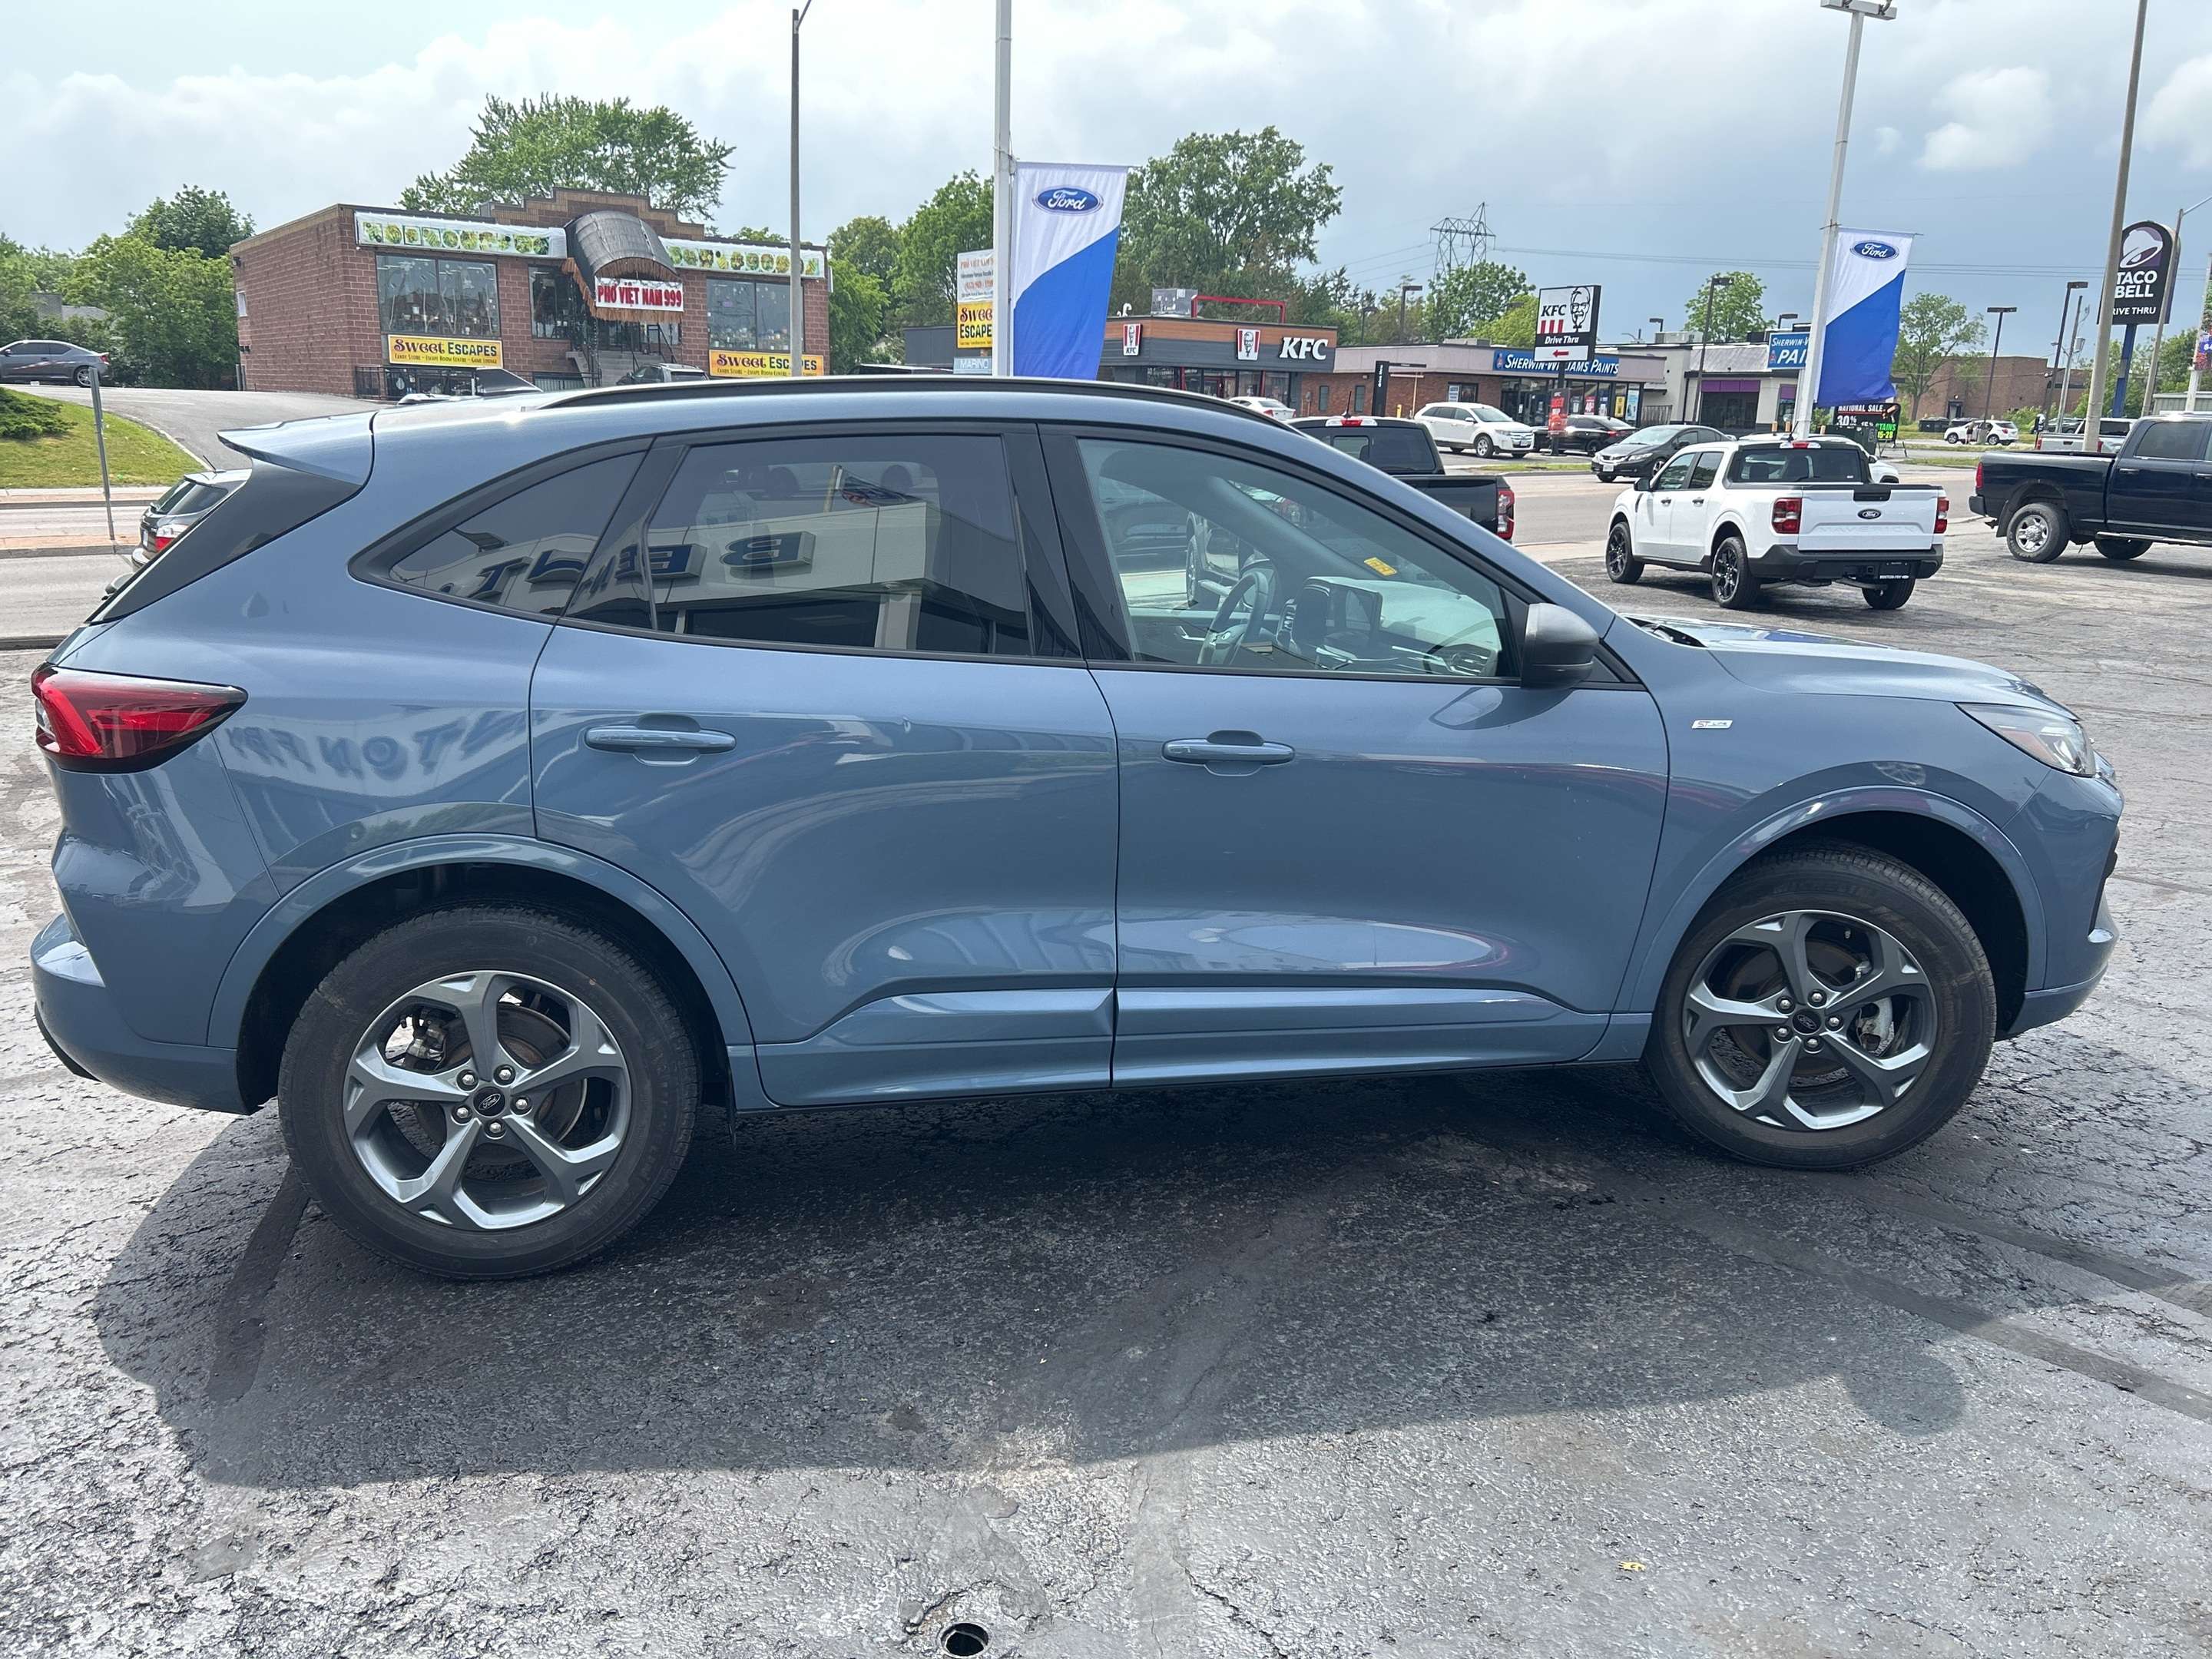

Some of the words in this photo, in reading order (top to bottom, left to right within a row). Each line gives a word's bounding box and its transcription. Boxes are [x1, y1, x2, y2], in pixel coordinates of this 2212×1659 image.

[1047, 189, 1088, 210] Ford
[1861, 243, 1888, 258] Ford
[2116, 270, 2157, 285] TACO
[641, 287, 663, 306] NAM
[664, 289, 682, 307] 999
[2114, 284, 2154, 299] BELL
[960, 307, 993, 323] Swee
[1541, 304, 1567, 316] KFC
[2112, 307, 2130, 316] RIVE
[2131, 306, 2156, 315] THRU
[960, 323, 992, 339] ESCAPE
[393, 339, 445, 355] Sweet
[448, 342, 498, 357] ESCAPES
[1544, 336, 1562, 345] Drive
[1563, 336, 1580, 344] Thru
[1771, 337, 1808, 346] SHERWIN-
[1279, 337, 1329, 360] KFC
[717, 353, 767, 369] Sweet
[769, 356, 817, 371] ESCES
[1777, 349, 1807, 364] PAI
[1590, 359, 1619, 375] PAINTS
[1838, 404, 1866, 412] NATIONAL
[1867, 404, 1884, 412] SALE
